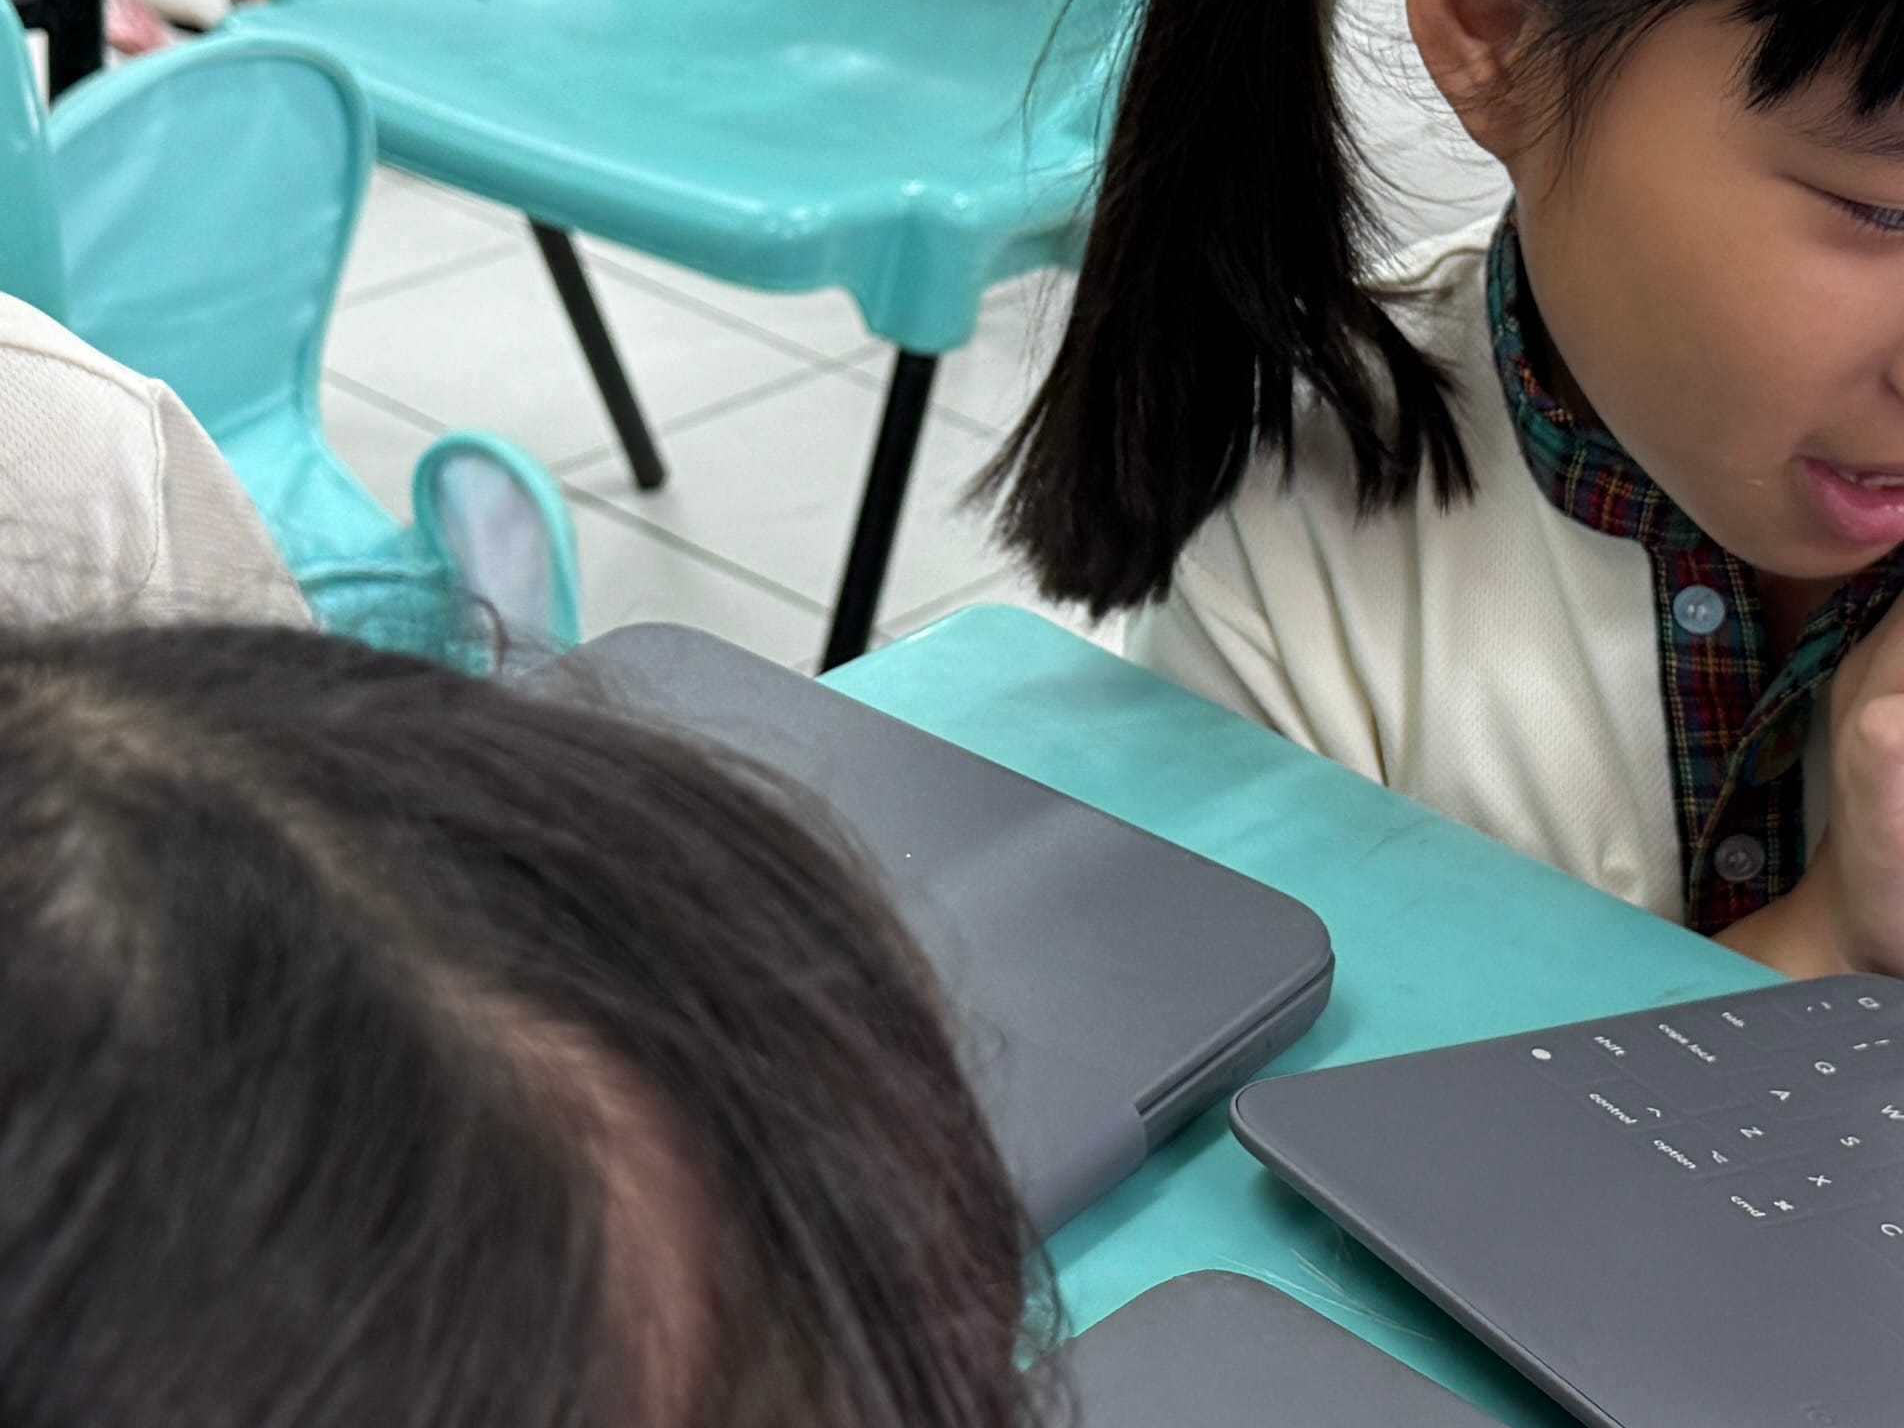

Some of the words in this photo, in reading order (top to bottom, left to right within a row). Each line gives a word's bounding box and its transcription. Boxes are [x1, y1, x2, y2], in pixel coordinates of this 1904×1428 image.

[1721, 1012, 1745, 1028] tab
[1594, 1036, 1625, 1057] shift
[1659, 1024, 1688, 1045] caps
[1688, 1043, 1716, 1063] lock
[1814, 1061, 1836, 1075] Q
[1769, 1090, 1791, 1101] A
[1589, 1093, 1638, 1125] control
[1739, 1126, 1764, 1139] Z
[1839, 1136, 1861, 1147] S
[1653, 1139, 1697, 1170] option
[1807, 1174, 1833, 1187] X
[1730, 1195, 1767, 1218] cmd
[1880, 1223, 1904, 1237] C
